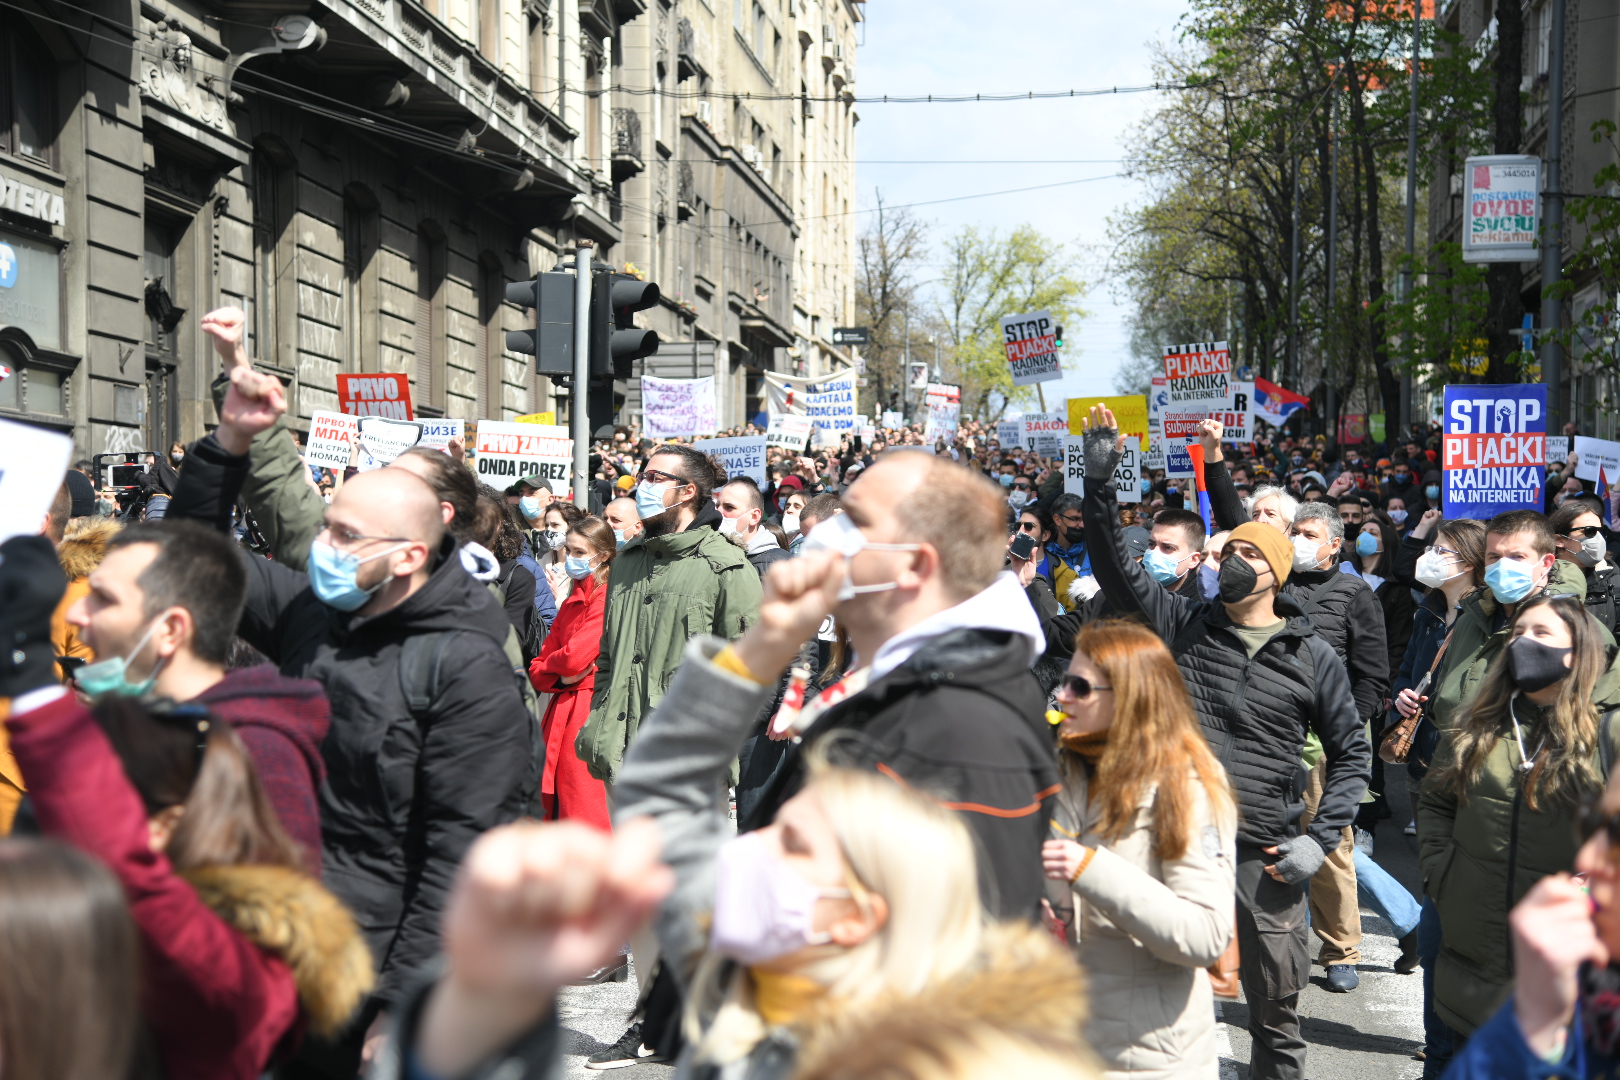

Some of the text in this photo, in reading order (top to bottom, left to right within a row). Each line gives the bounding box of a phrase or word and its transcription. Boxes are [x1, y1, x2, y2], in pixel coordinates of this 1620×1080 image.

[1472, 199, 1534, 217] OVDE
[1005, 318, 1050, 343] STOP
[1012, 353, 1058, 370] RADNIKA
[347, 377, 399, 400] PRVO
[805, 384, 819, 394] NA
[1170, 373, 1228, 392] RADNIKA
[1171, 393, 1183, 402] NA
[1183, 386, 1229, 401] INTERNETU!
[345, 400, 408, 421] ZAKON
[1450, 398, 1541, 434] STOP
[317, 416, 345, 428] ПРВО
[834, 419, 853, 429] DOM
[480, 433, 519, 453] PRVO
[479, 458, 566, 480] ONDA POREZ
[726, 454, 760, 469] NAŠE
[1450, 466, 1541, 489] RADNIKA
[1450, 487, 1540, 504] NA INTERNETU!
